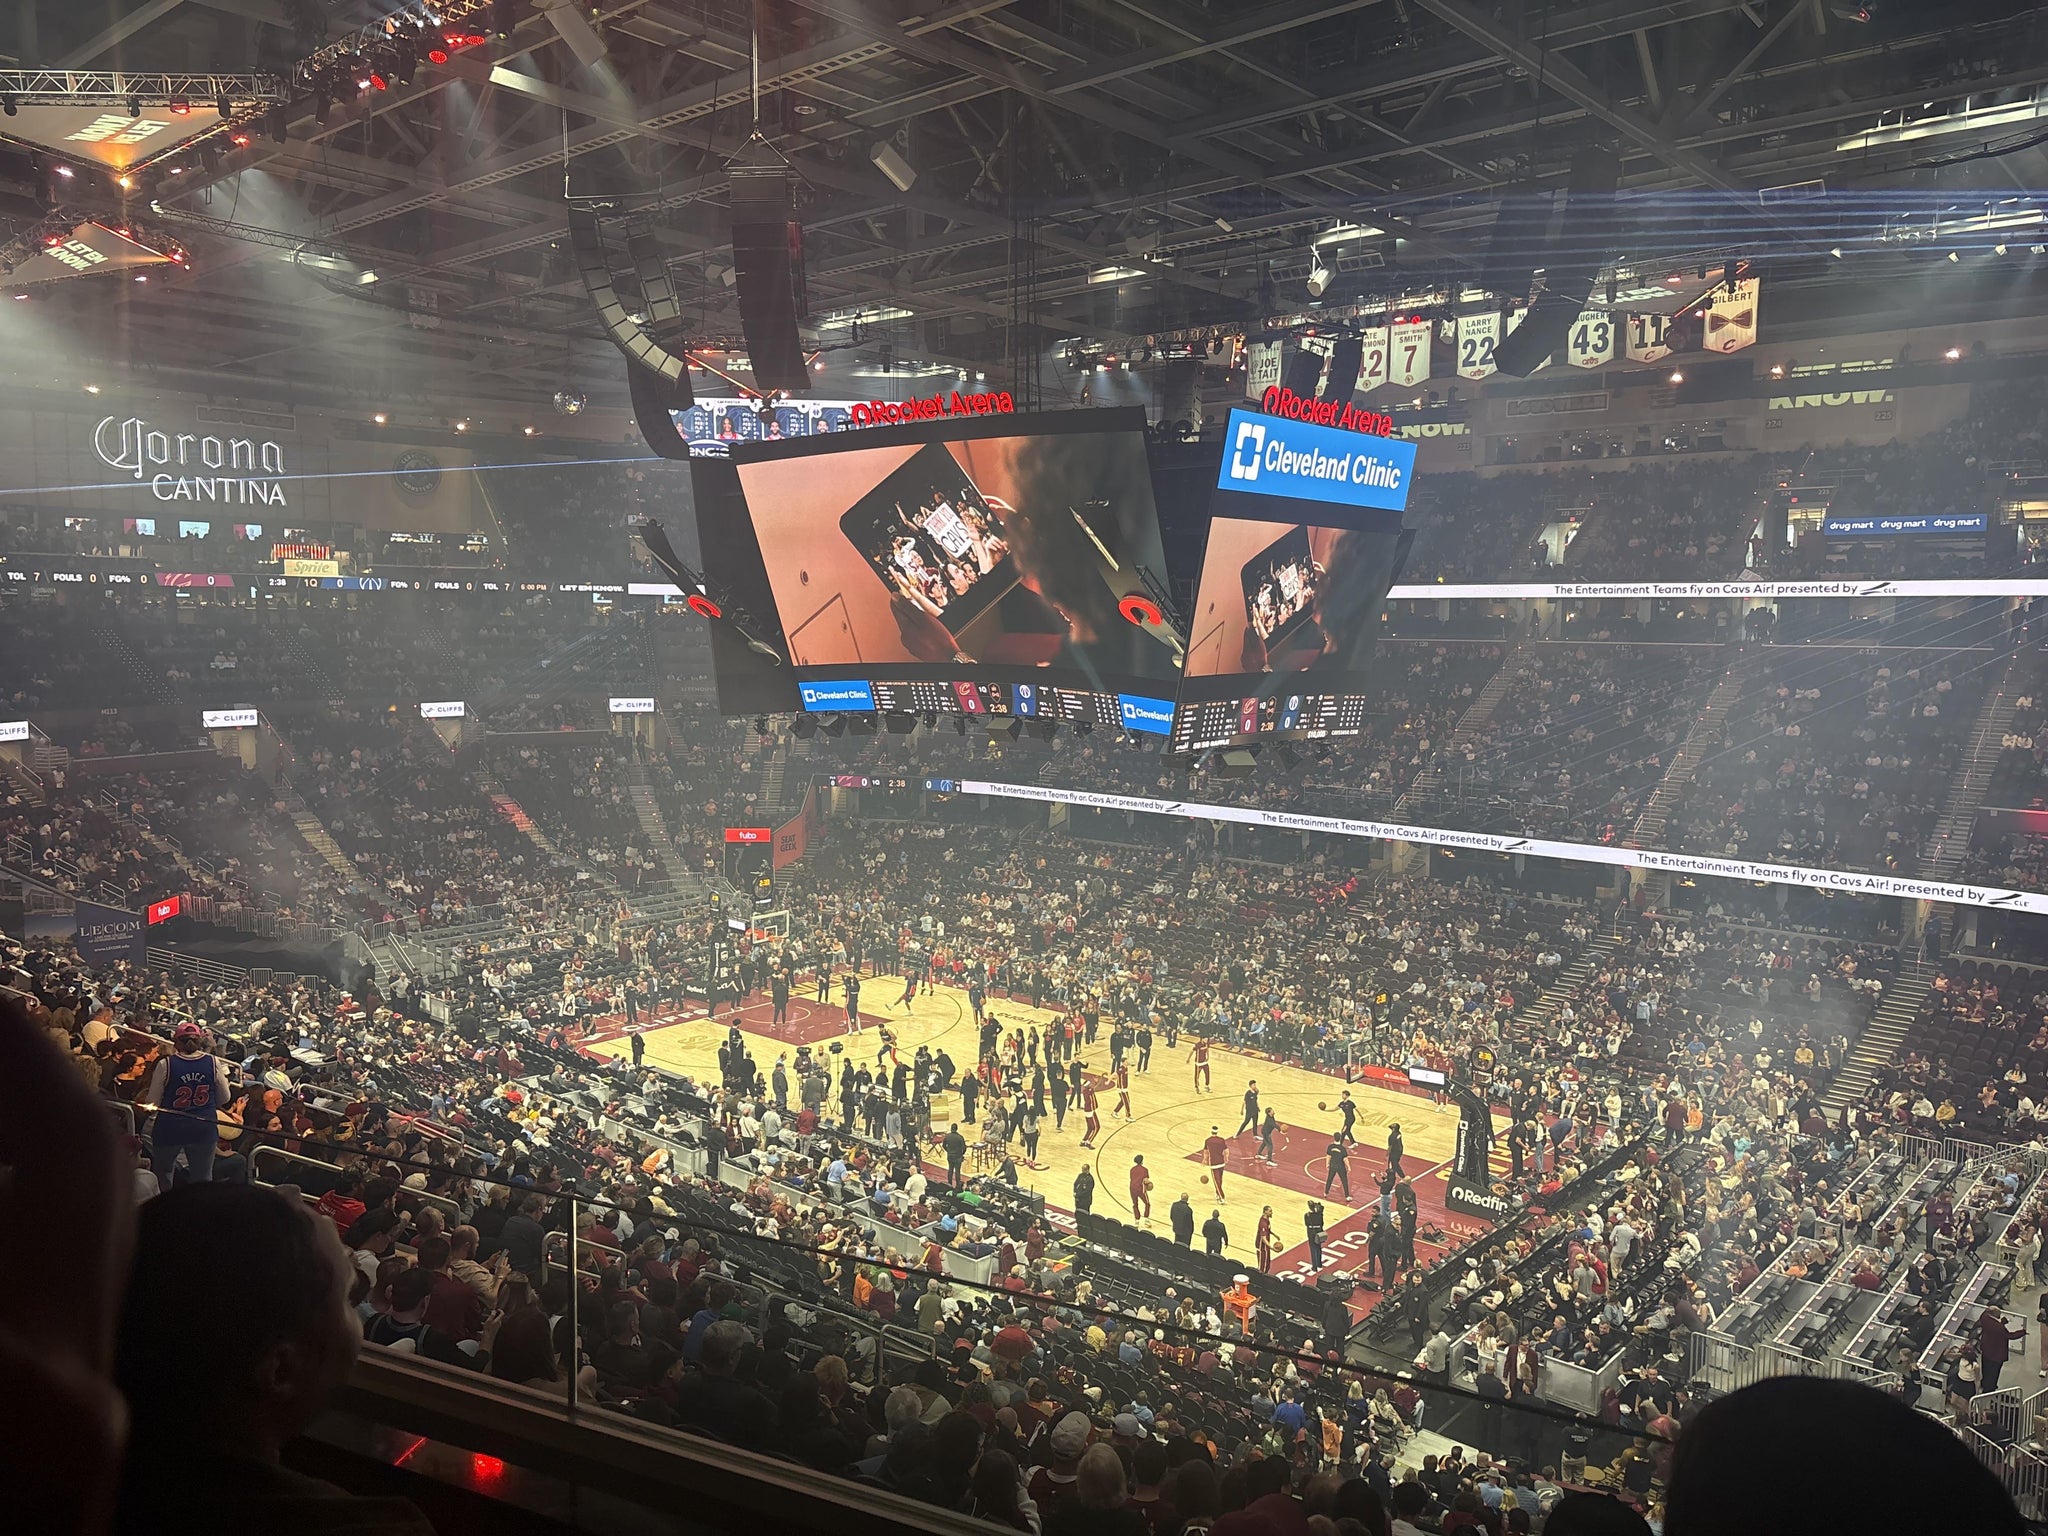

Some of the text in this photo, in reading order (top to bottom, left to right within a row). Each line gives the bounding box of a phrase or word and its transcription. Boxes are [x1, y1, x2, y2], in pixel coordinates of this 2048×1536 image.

[1720, 284, 1744, 295] NCK
[1712, 292, 1753, 304] GILBERT
[1466, 318, 1492, 328] LARRY
[1465, 326, 1492, 336] NANCE
[1635, 314, 1666, 349] 11
[1399, 334, 1423, 343] SMITH
[1573, 322, 1610, 354] 43
[1462, 337, 1496, 368] 22
[1260, 357, 1277, 369] JOE
[1404, 345, 1417, 373] 7
[1258, 368, 1278, 380] TAIT
[872, 390, 1014, 425] Rocket Arena
[1278, 387, 1394, 437] Rocket Arena
[90, 415, 287, 479] Corona
[1265, 439, 1401, 490] Cleveland Clinic
[152, 473, 287, 506] CANTINA
[1830, 518, 1981, 531] drug mart drug mart drug mart
[294, 561, 330, 574] Sprite
[7, 572, 148, 584] TOL 7 FOULS 0 FG% 0
[207, 576, 215, 586] 0
[304, 579, 318, 588] 1Q
[336, 578, 344, 588] 0
[414, 581, 420, 590] 0
[434, 582, 460, 590] FOULS
[466, 582, 472, 591] 0
[504, 583, 510, 591] 7
[1555, 585, 1573, 594] The
[1575, 585, 1649, 594] Entertainment
[1653, 585, 1687, 594] Teams
[1723, 584, 1750, 594] Cavs
[1753, 583, 1774, 594] Air!
[1777, 583, 1840, 598] presented
[1843, 582, 1858, 595] by
[815, 690, 868, 700] Cleveland Clinic
[967, 699, 1028, 713] 0 2:38 0
[224, 714, 255, 722] CLIFFS
[1135, 707, 1170, 722] Cleveland
[1245, 721, 1251, 732] 0
[1284, 717, 1291, 728] 0
[0, 727, 26, 736] CLIFFS
[861, 778, 867, 787] 0
[889, 780, 906, 788] 2:38
[926, 780, 932, 789] 0
[990, 785, 1001, 794] The
[1003, 786, 1046, 798] Entertainment
[1048, 789, 1068, 800] Teams
[1088, 794, 1104, 803] Cavs
[1106, 795, 1117, 805] Air!
[1119, 798, 1154, 811] presented
[1155, 800, 1164, 812] by
[739, 831, 757, 839] fubo
[1262, 813, 1277, 823] The
[1279, 815, 1339, 830] Entertainment
[1341, 821, 1368, 833] Teams
[1397, 827, 1419, 839] Cavs
[1421, 829, 1438, 841] Air!
[1440, 833, 1488, 847] presented
[1491, 836, 1503, 848] by
[781, 835, 796, 844] SEAT
[1637, 853, 1658, 865] The
[1661, 856, 1745, 875] Entertainment
[1750, 865, 1789, 880] Teams
[1830, 874, 1862, 887] Cavs
[1865, 877, 1889, 890] Air!
[1893, 882, 1964, 900] presented
[1968, 888, 1985, 903] by
[158, 905, 171, 917] fubo
[181, 1072, 206, 1083] PRICE
[173, 1085, 210, 1108] 25
